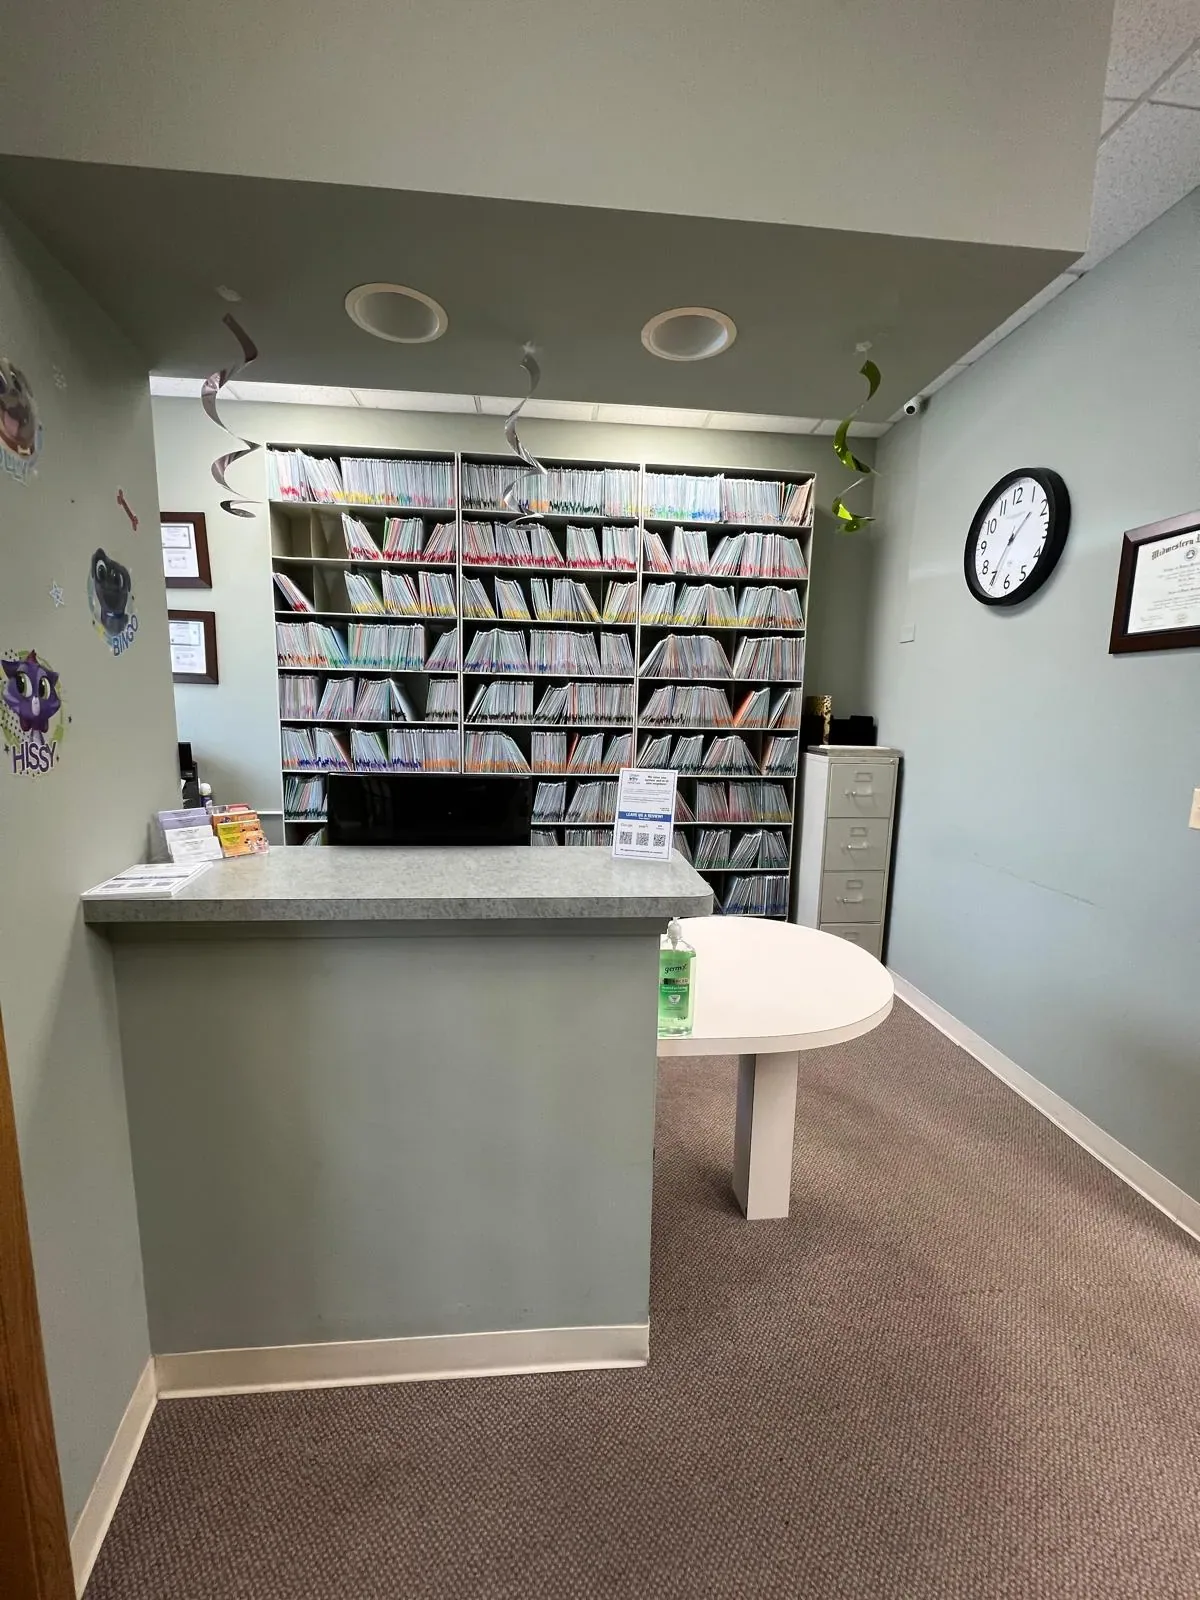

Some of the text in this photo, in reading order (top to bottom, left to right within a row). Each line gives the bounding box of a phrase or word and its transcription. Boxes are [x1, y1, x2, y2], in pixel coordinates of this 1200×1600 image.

[1012, 487, 1024, 506] 12
[1032, 486, 1036, 503] 1
[999, 499, 1007, 517] 11
[1040, 499, 1048, 517] 2
[986, 518, 997, 535] 10
[1041, 522, 1049, 539] 3
[980, 540, 987, 556] 9
[1033, 545, 1041, 559] 4
[1152, 540, 1194, 561] Midwestern
[982, 560, 989, 575] 8
[1019, 565, 1027, 581] 5
[990, 571, 998, 586] 7
[1003, 574, 1010, 590] 6
[113, 614, 138, 657] BINGO
[12, 741, 57, 774] HISSY
